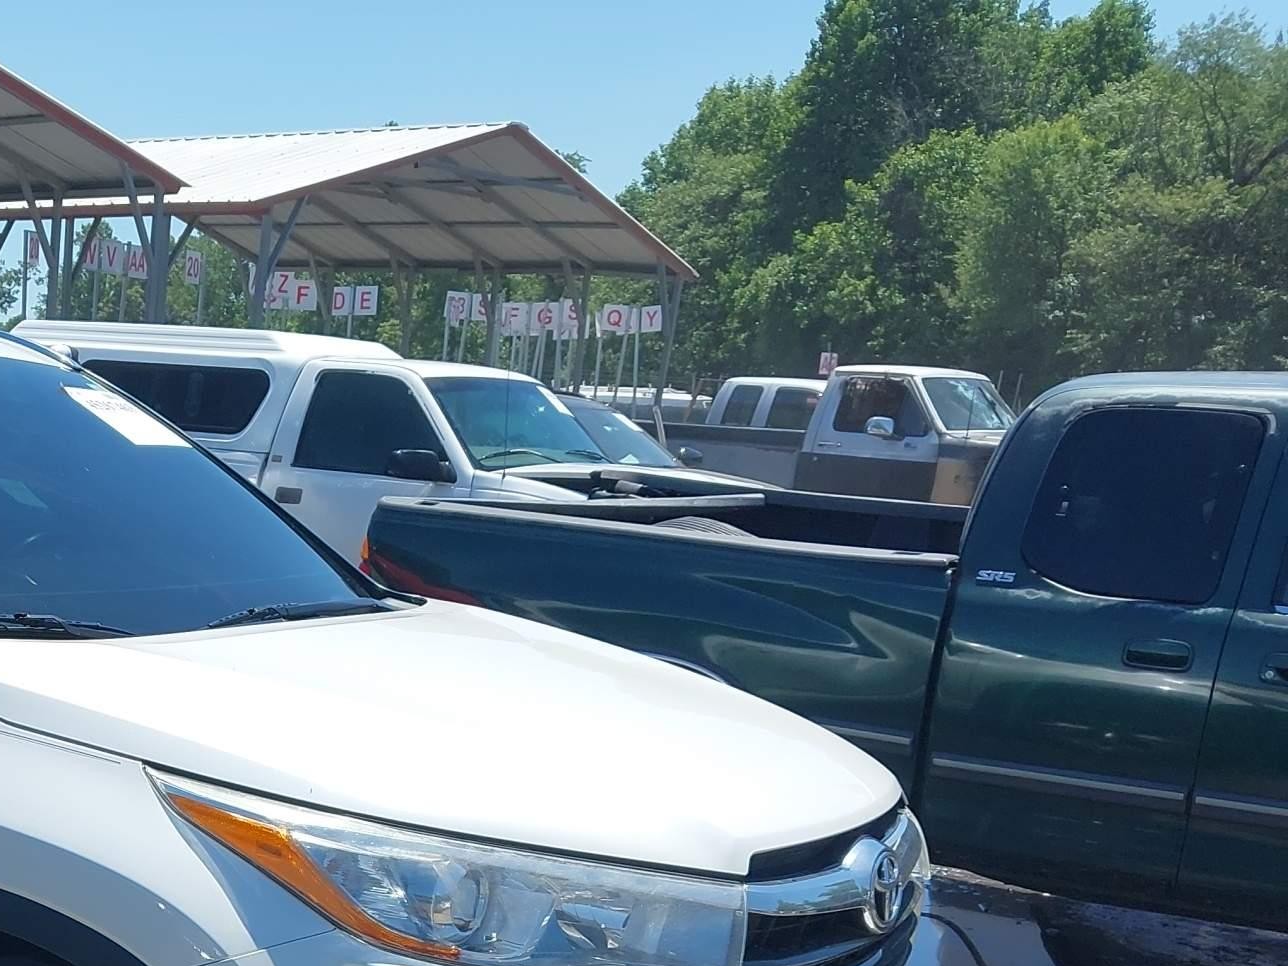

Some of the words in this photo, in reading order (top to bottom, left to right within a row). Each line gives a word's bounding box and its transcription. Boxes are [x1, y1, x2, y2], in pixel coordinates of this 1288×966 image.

[106, 245, 117, 267] V
[187, 255, 199, 278] 20
[278, 273, 289, 294] Z
[296, 285, 310, 305] F
[333, 292, 345, 310] D
[360, 291, 372, 310] E
[537, 307, 553, 325] G
[607, 309, 621, 327] Q
[646, 309, 658, 328] Y
[975, 569, 1017, 583] SR5
